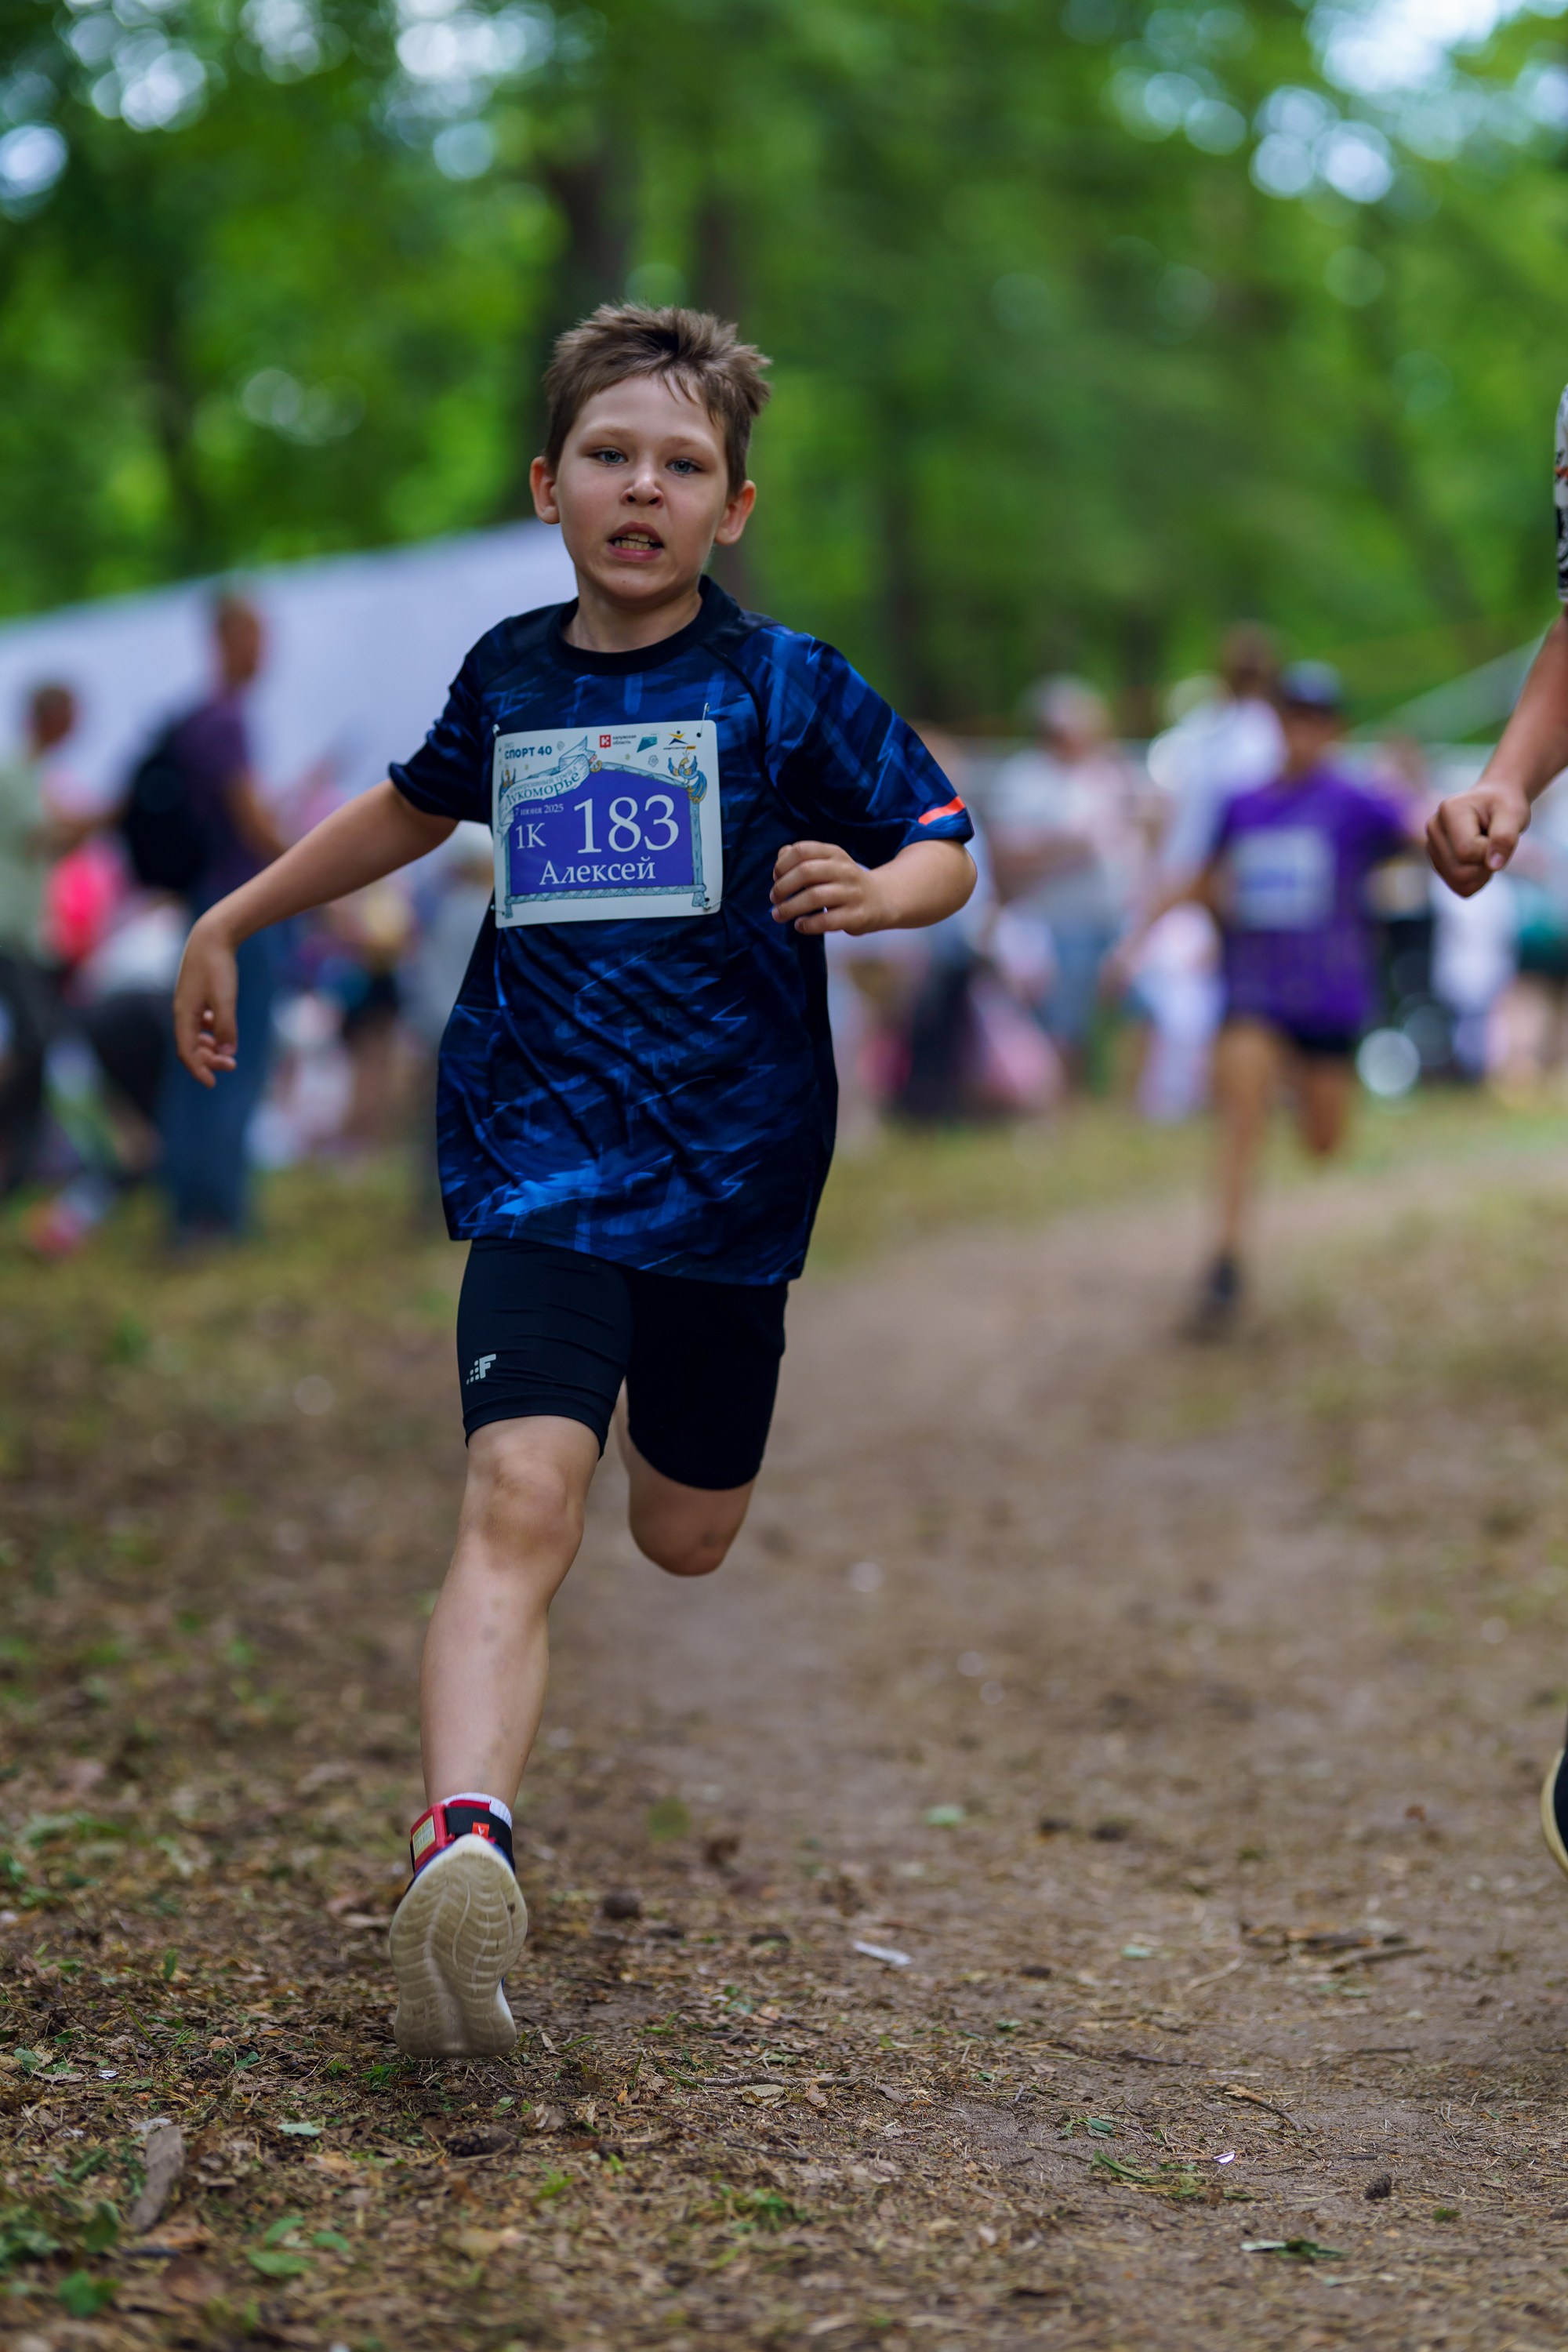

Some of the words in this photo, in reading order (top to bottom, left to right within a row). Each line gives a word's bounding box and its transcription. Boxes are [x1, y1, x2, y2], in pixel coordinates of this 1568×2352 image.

[504, 746, 535, 760] СПОРТ
[537, 746, 553, 756] 40
[505, 771, 580, 807] Лукоморье
[521, 807, 543, 816] июня
[544, 804, 564, 813] 2025
[573, 794, 680, 855] 183
[514, 822, 546, 850] 1K
[539, 856, 655, 886] Алексей
